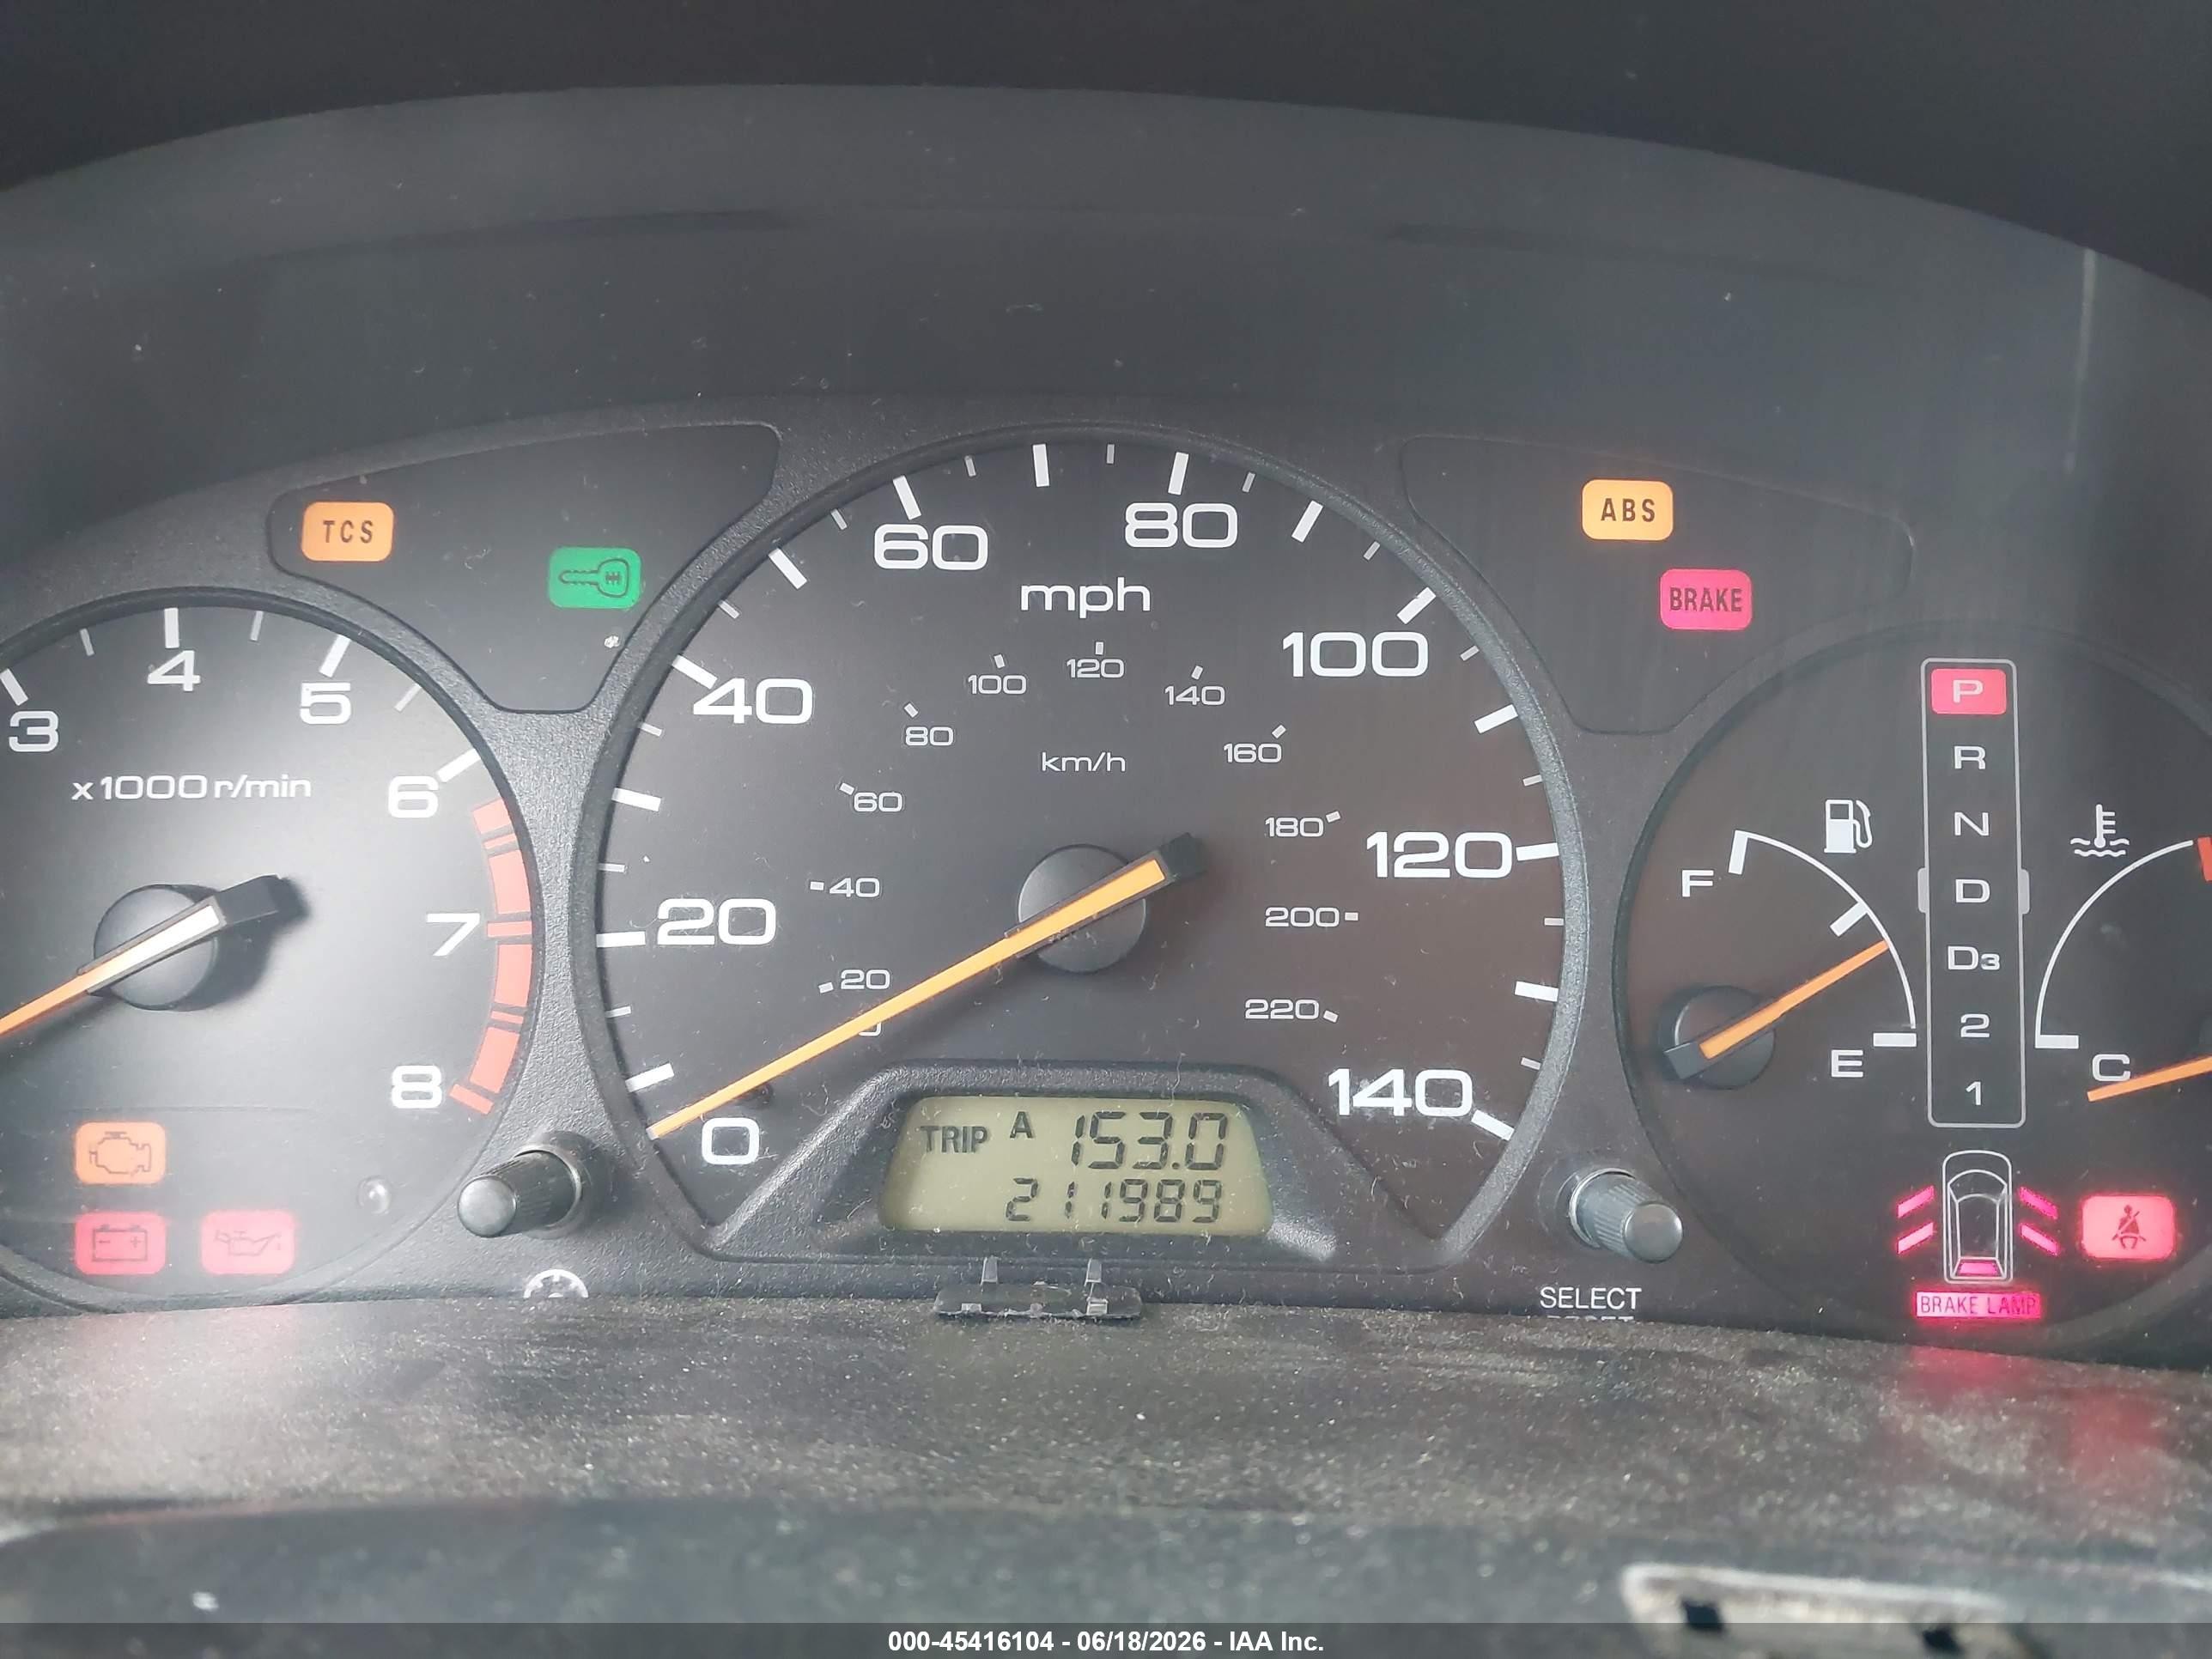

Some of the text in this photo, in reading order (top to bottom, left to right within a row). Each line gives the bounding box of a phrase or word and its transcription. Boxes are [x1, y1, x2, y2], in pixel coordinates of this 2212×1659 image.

[1601, 497, 1655, 522] ABS
[322, 520, 374, 544] TCS
[1125, 502, 1237, 548] 80
[874, 524, 988, 570] 60
[1020, 577, 1151, 618] mph
[1669, 586, 1742, 611] BRAKE
[1282, 631, 1428, 677] 100
[147, 650, 200, 690] 4
[1066, 659, 1125, 678] 120
[967, 674, 1027, 694] 100
[1164, 685, 1225, 705] 140
[1952, 679, 1984, 703] P
[300, 683, 351, 724] 5
[693, 678, 813, 724] 40
[9, 710, 58, 752] 3
[904, 726, 954, 745] 80
[1041, 752, 1126, 773] km/h
[1224, 743, 1282, 763] 160
[1954, 745, 1986, 769] R
[388, 775, 439, 818] 6
[854, 792, 903, 812] 60
[1265, 817, 1323, 837] 180
[1954, 811, 1990, 836] N
[1366, 831, 1512, 878] 120
[829, 878, 880, 897] 40
[1681, 869, 1714, 897] F
[1955, 878, 1990, 903] D
[657, 898, 776, 945] 20
[1265, 908, 1340, 927] 200
[426, 913, 480, 956] 7
[841, 969, 890, 989] 20
[1245, 1000, 1319, 1019] 220
[1960, 1014, 1990, 1038] 2
[1832, 1050, 1863, 1078] E
[2092, 1054, 2131, 1082] C
[392, 1065, 442, 1108] 8
[1328, 1068, 1473, 1116] 140
[1966, 1082, 1983, 1106] 1
[702, 1118, 760, 1165] 0
[920, 1111, 1228, 1170] TRIP A 153.0
[1006, 1178, 1223, 1223] 211989
[1540, 1286, 1642, 1310] SELECT
[1920, 1296, 2036, 1315] BRAKE LAMP
